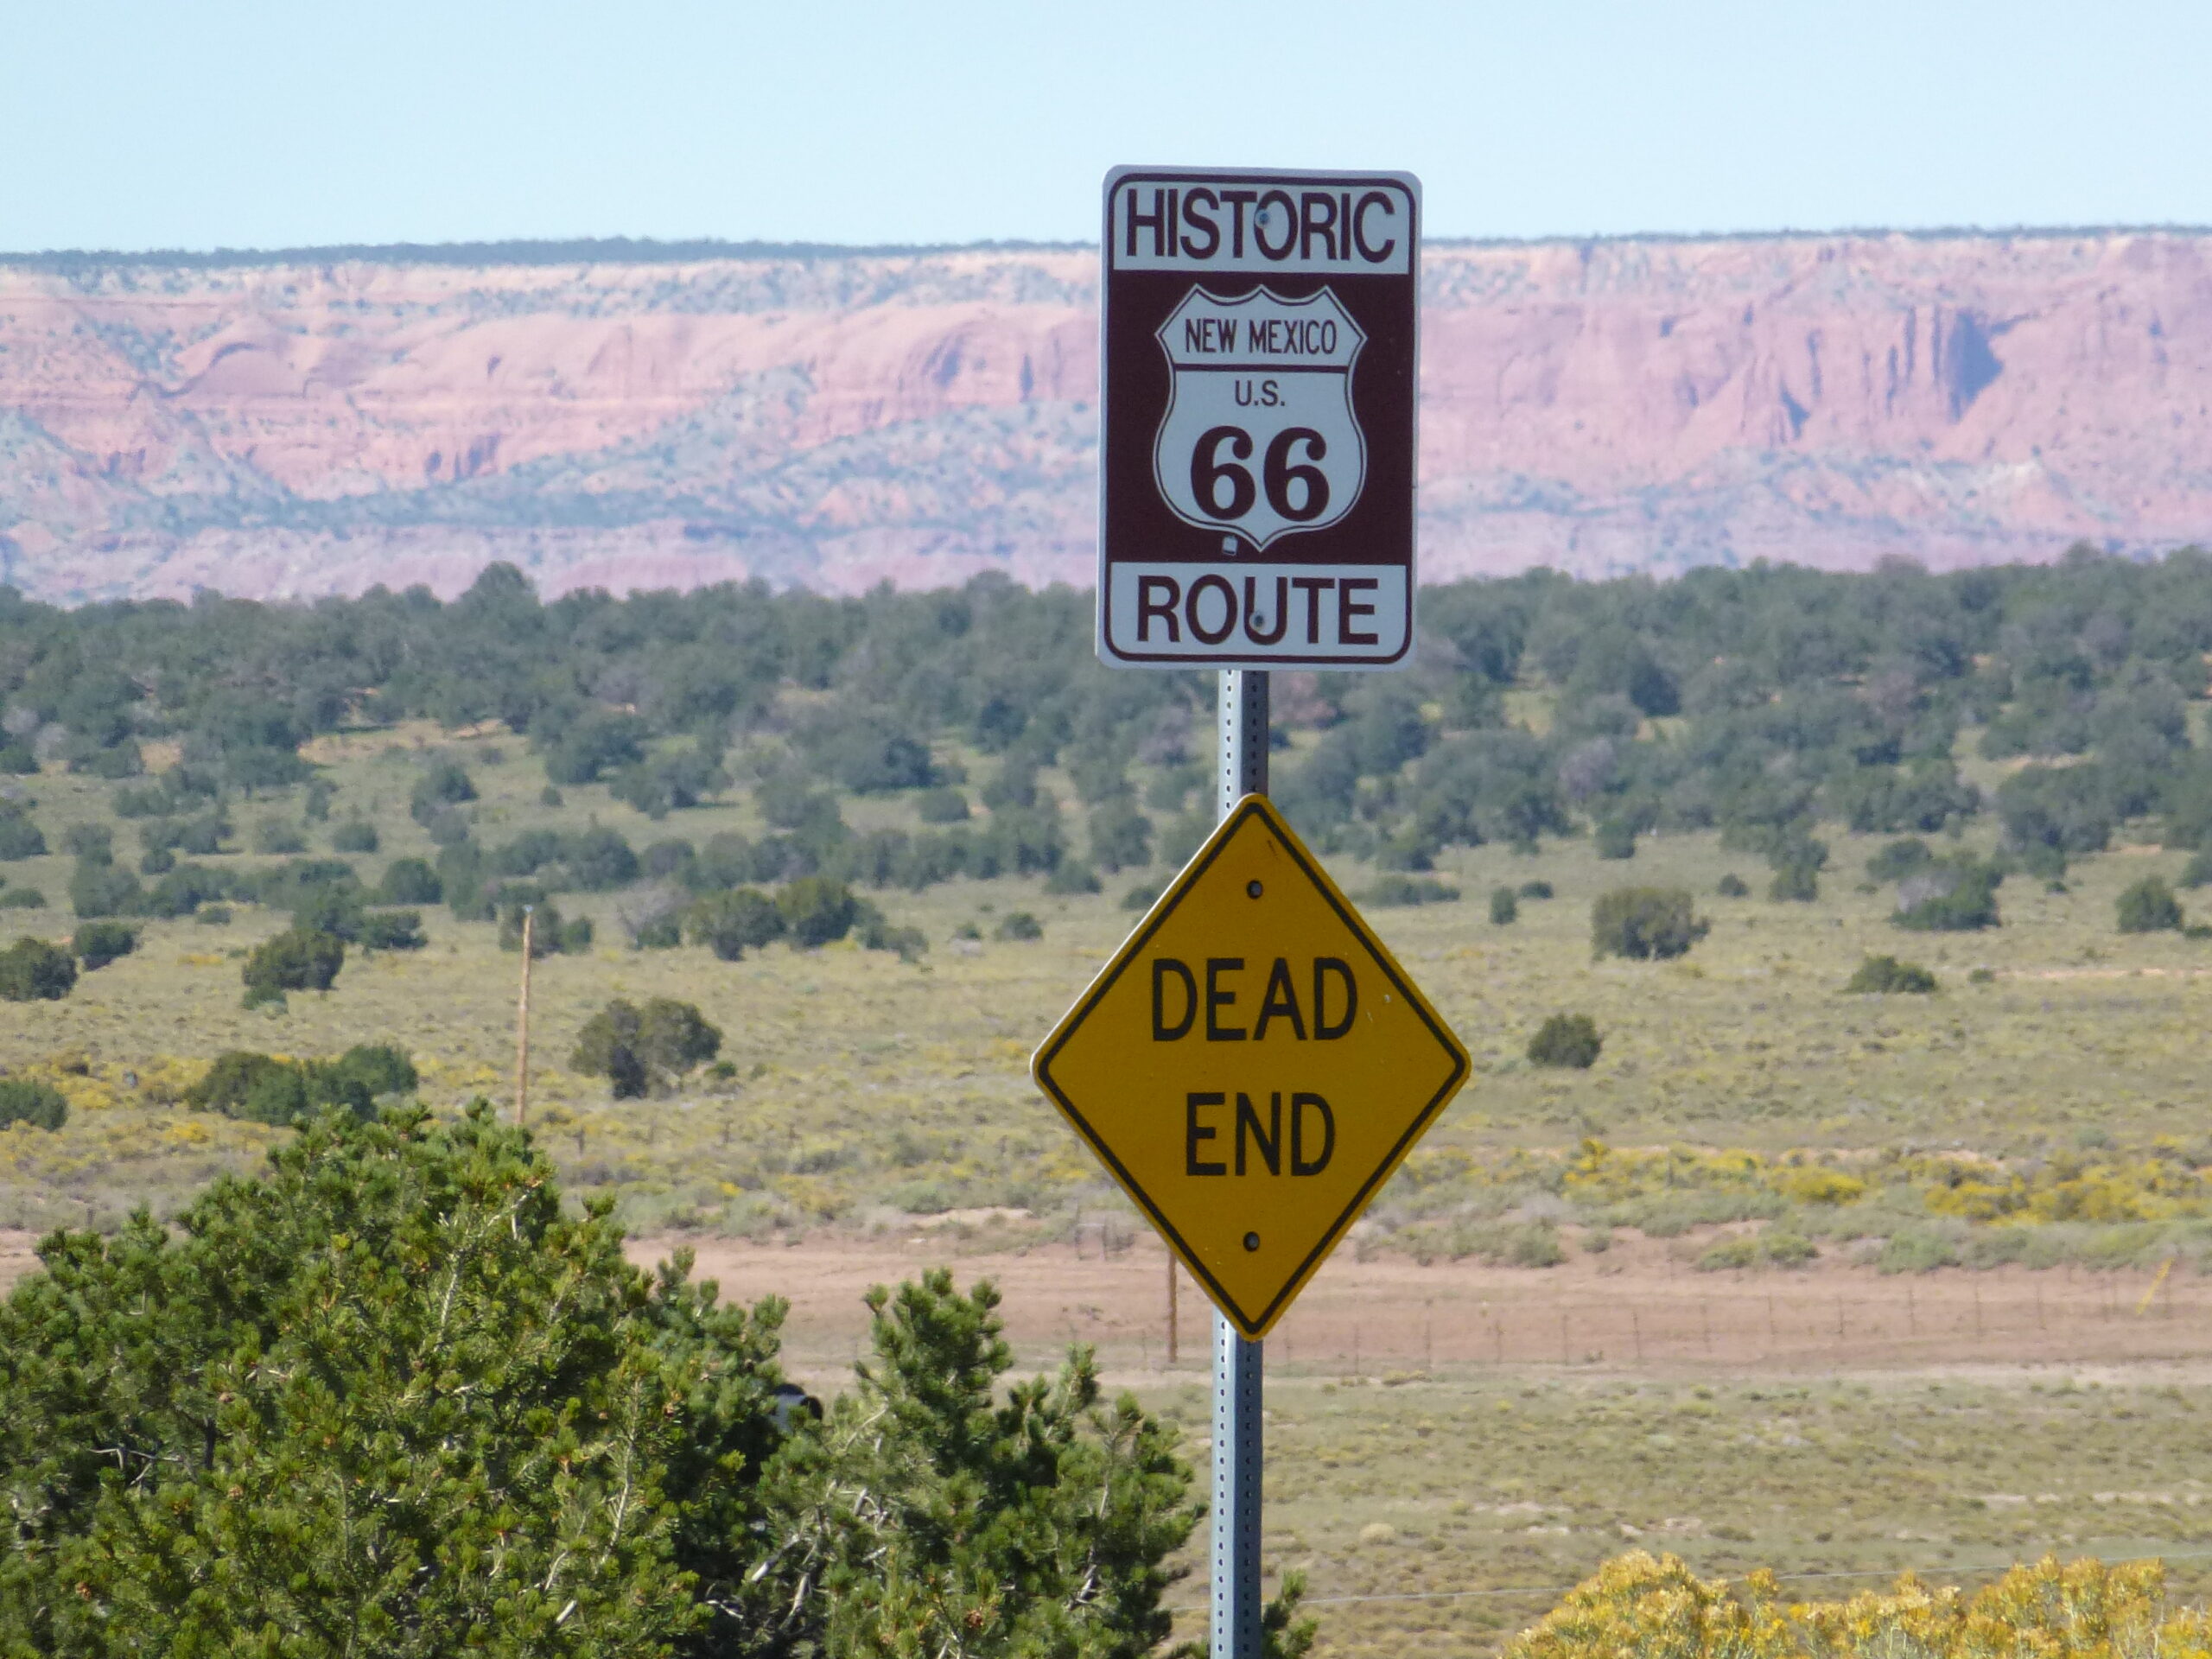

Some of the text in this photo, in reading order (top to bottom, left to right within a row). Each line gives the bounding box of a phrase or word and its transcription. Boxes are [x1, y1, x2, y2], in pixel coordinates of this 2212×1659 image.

[1127, 188, 1395, 263] HISTORIC
[1185, 318, 1337, 355] NEW MEXICO
[1235, 380, 1286, 407] U.S.
[1191, 425, 1330, 521] 66
[1137, 574, 1378, 645] ROUTE
[1152, 957, 1357, 1041] DEAD
[1185, 1092, 1335, 1176] END
